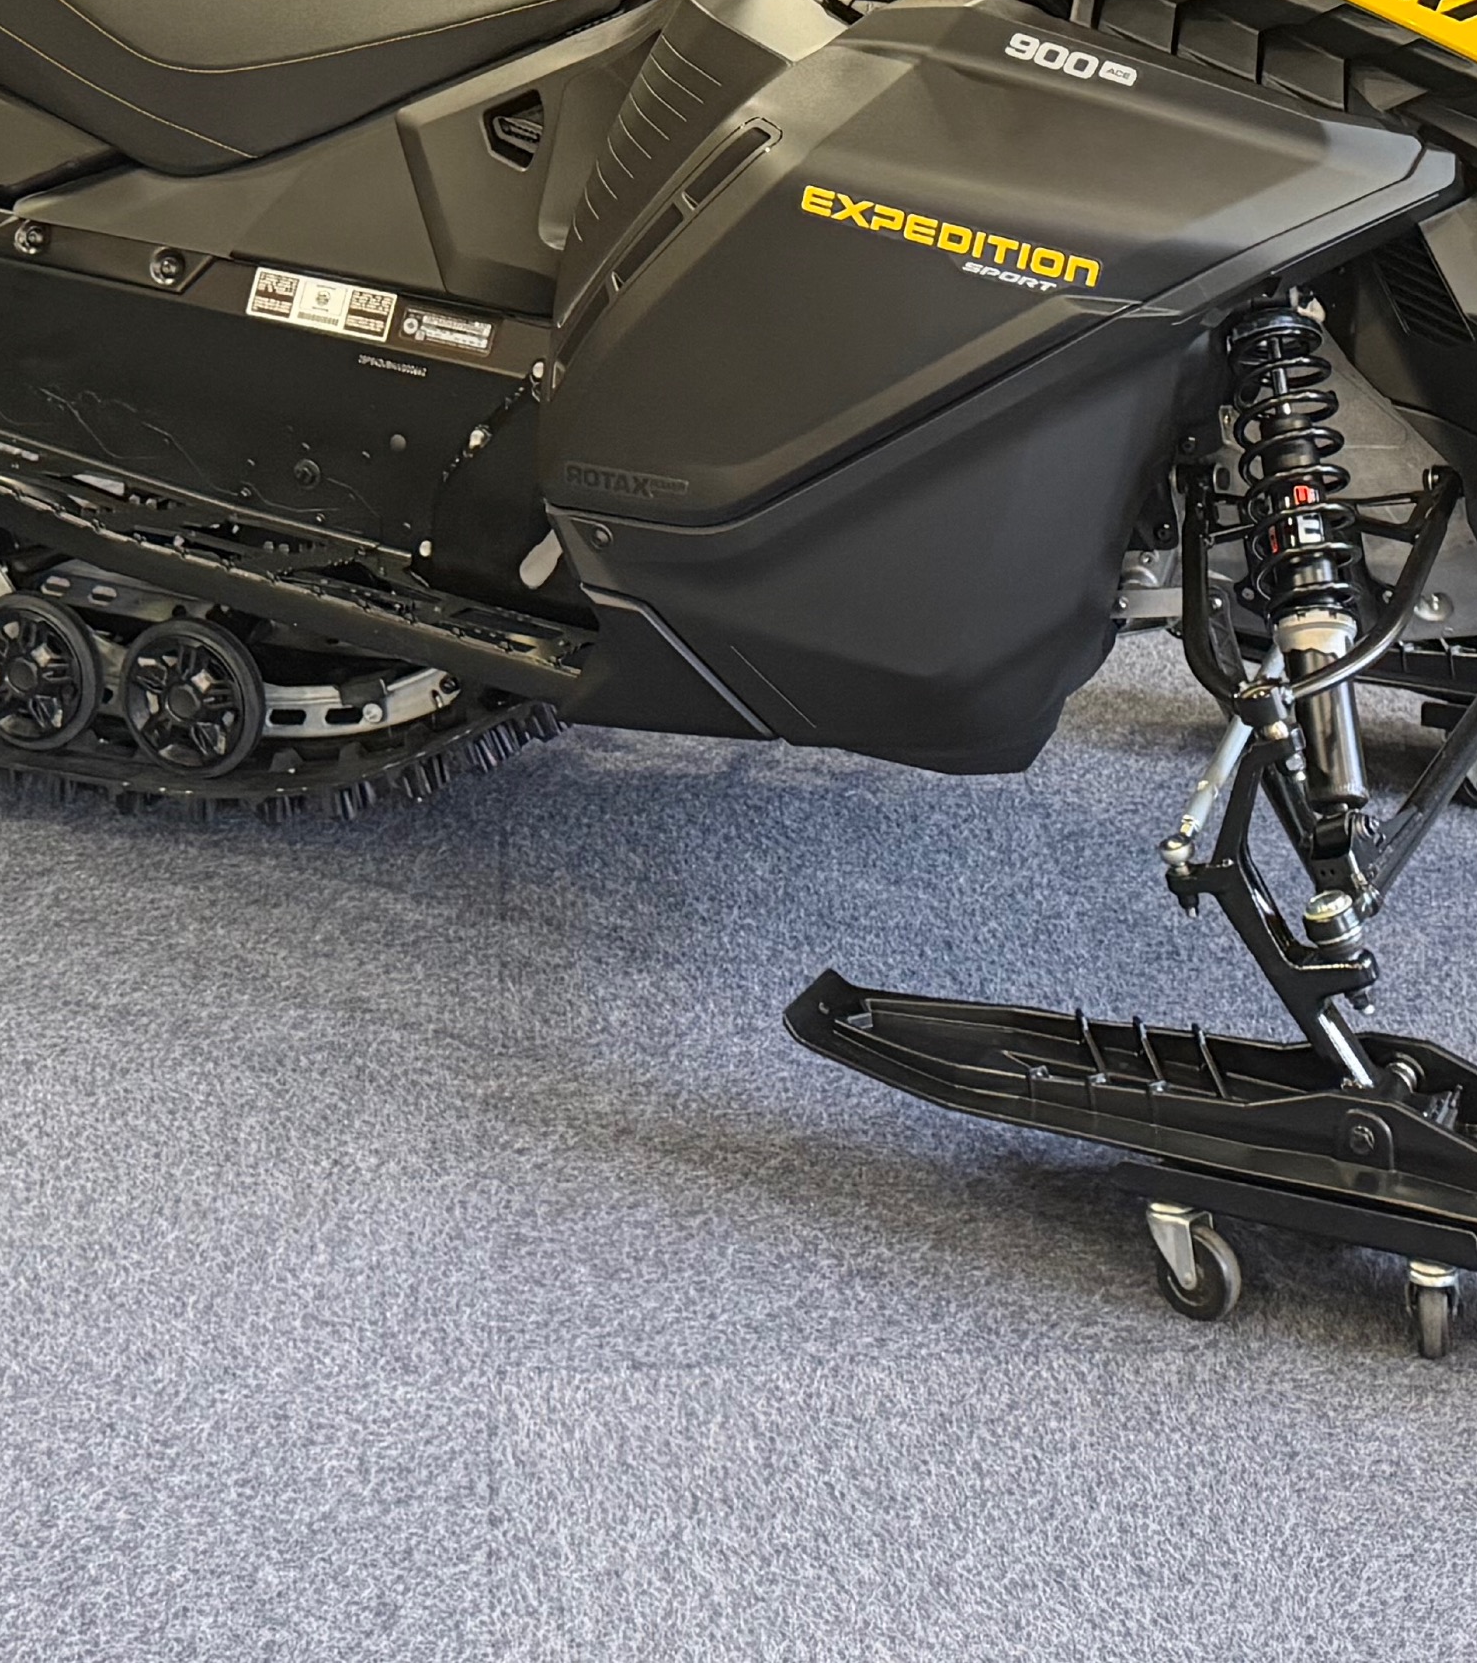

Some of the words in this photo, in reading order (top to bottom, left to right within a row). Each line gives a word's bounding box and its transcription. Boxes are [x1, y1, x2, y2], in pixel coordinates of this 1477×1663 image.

[1004, 32, 1099, 79] 900
[1105, 66, 1131, 80] ACE
[801, 185, 1101, 288] EXPEDITION
[962, 261, 1058, 292] SPORT
[565, 463, 652, 498] ROTAX
